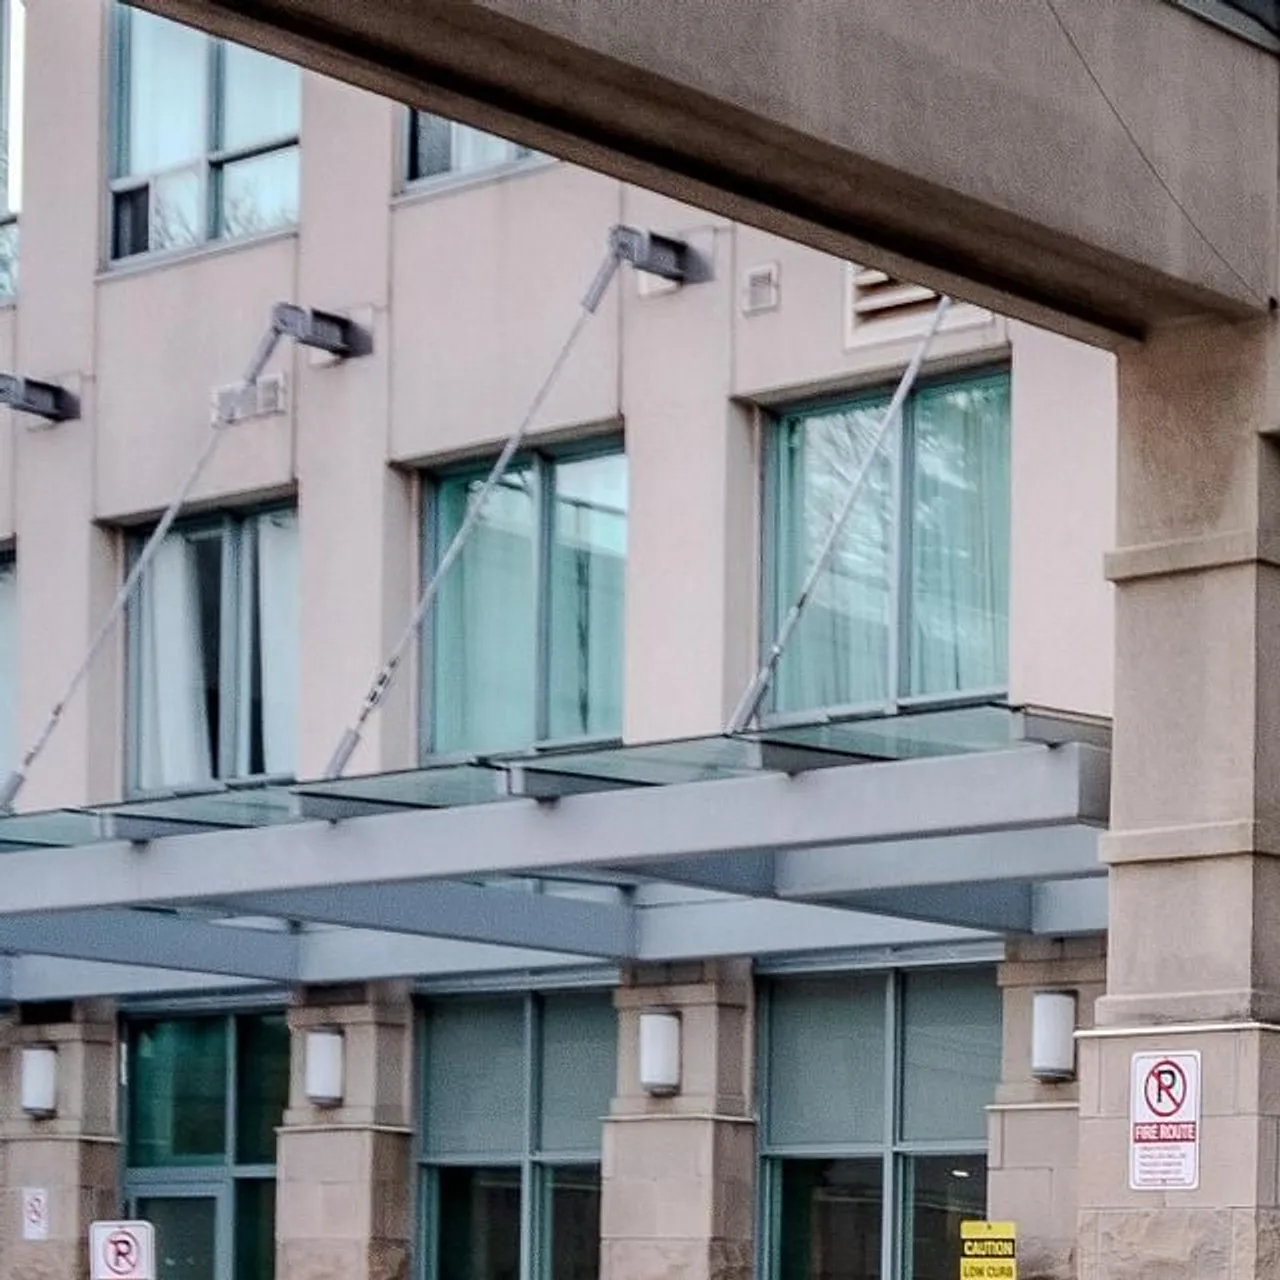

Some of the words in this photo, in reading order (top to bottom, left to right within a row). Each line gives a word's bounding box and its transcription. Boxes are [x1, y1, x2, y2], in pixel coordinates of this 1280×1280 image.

[1135, 1124, 1159, 1140] FIRE
[1160, 1123, 1194, 1139] ROUTE
[964, 1241, 1013, 1256] CAUTION
[963, 1265, 985, 1277] LOW
[986, 1265, 1013, 1278] CURB
